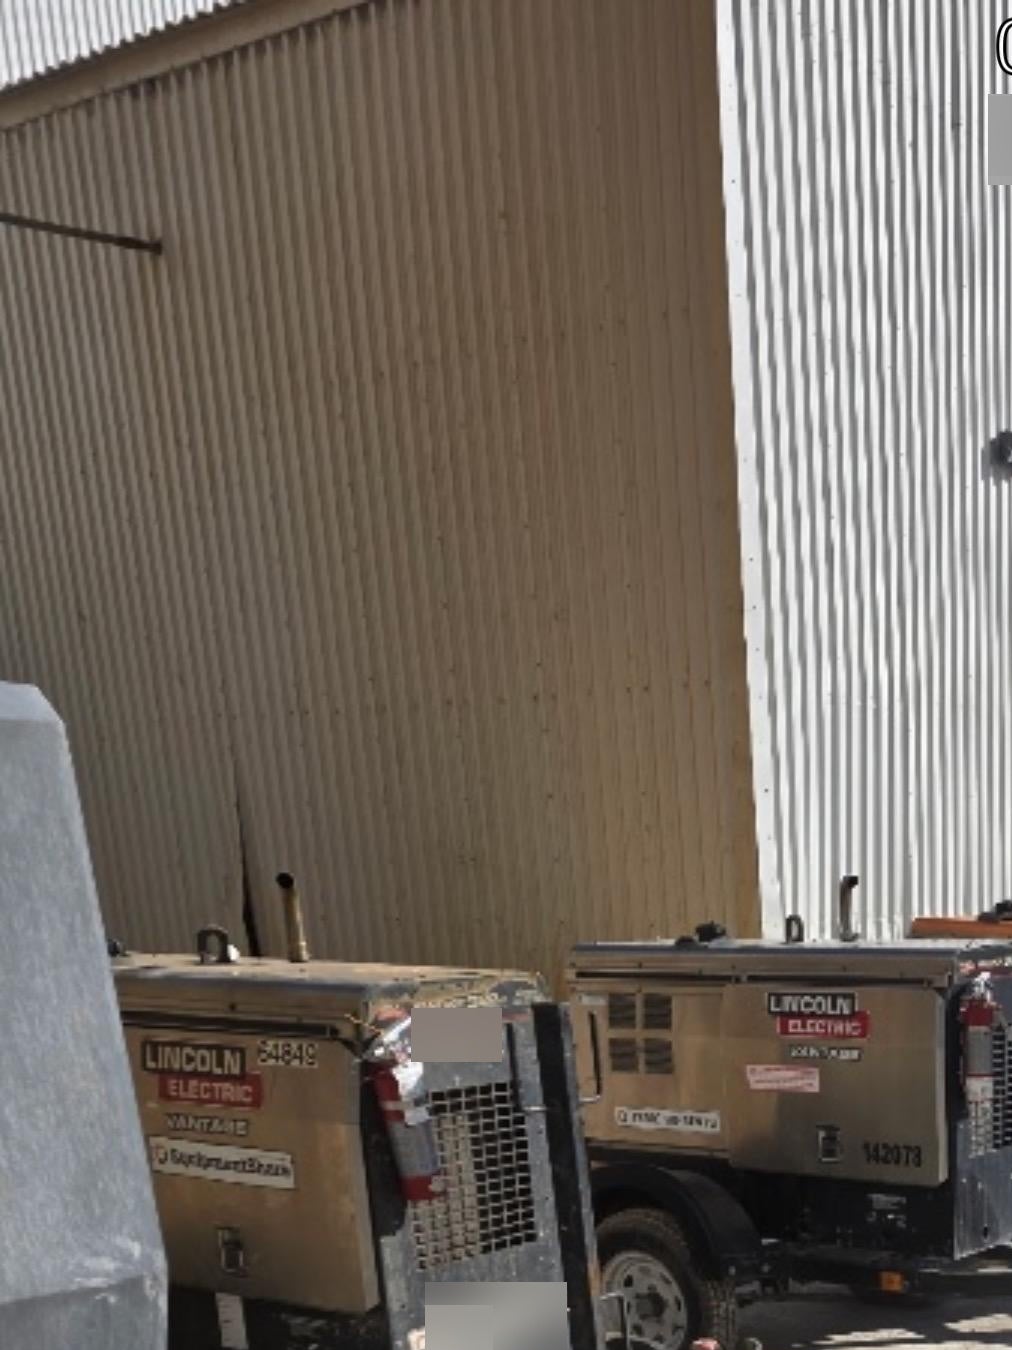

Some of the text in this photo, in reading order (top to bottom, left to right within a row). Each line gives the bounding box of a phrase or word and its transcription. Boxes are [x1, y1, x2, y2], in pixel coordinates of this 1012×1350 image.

[769, 994, 851, 1015] LINCOLN
[787, 1018, 862, 1036] ELECTRIC
[146, 1043, 242, 1076] LINCOLN
[168, 1078, 254, 1103] ELECTRIC
